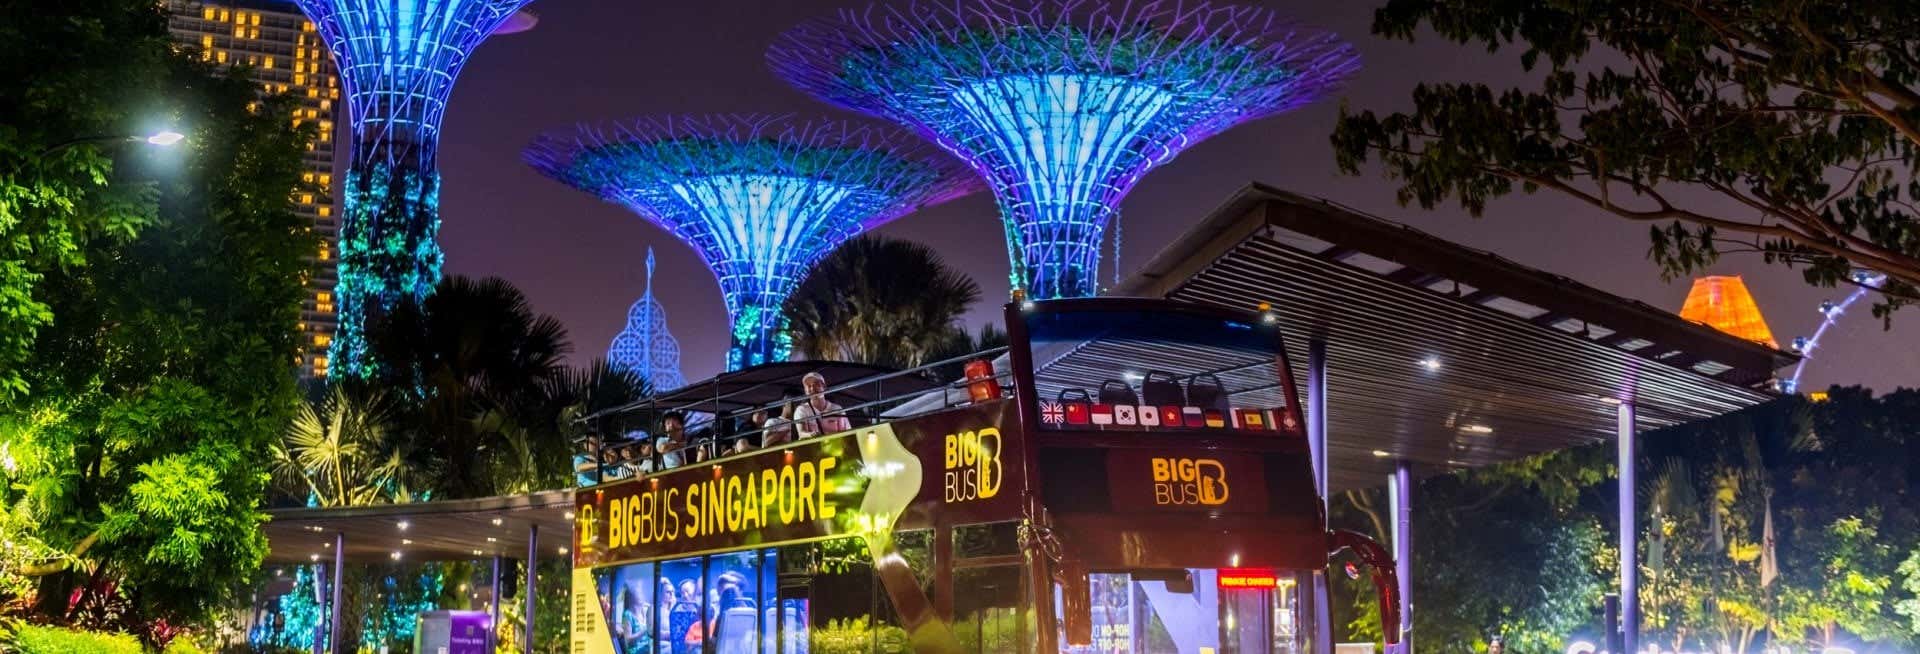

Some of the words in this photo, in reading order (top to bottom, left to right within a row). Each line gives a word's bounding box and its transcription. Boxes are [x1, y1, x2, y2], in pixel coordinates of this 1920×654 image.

[945, 431, 976, 469] BIG
[945, 468, 976, 503] BUS
[1152, 458, 1195, 482] BIG
[685, 457, 836, 539] SINGAPORE
[1155, 483, 1199, 505] BUS
